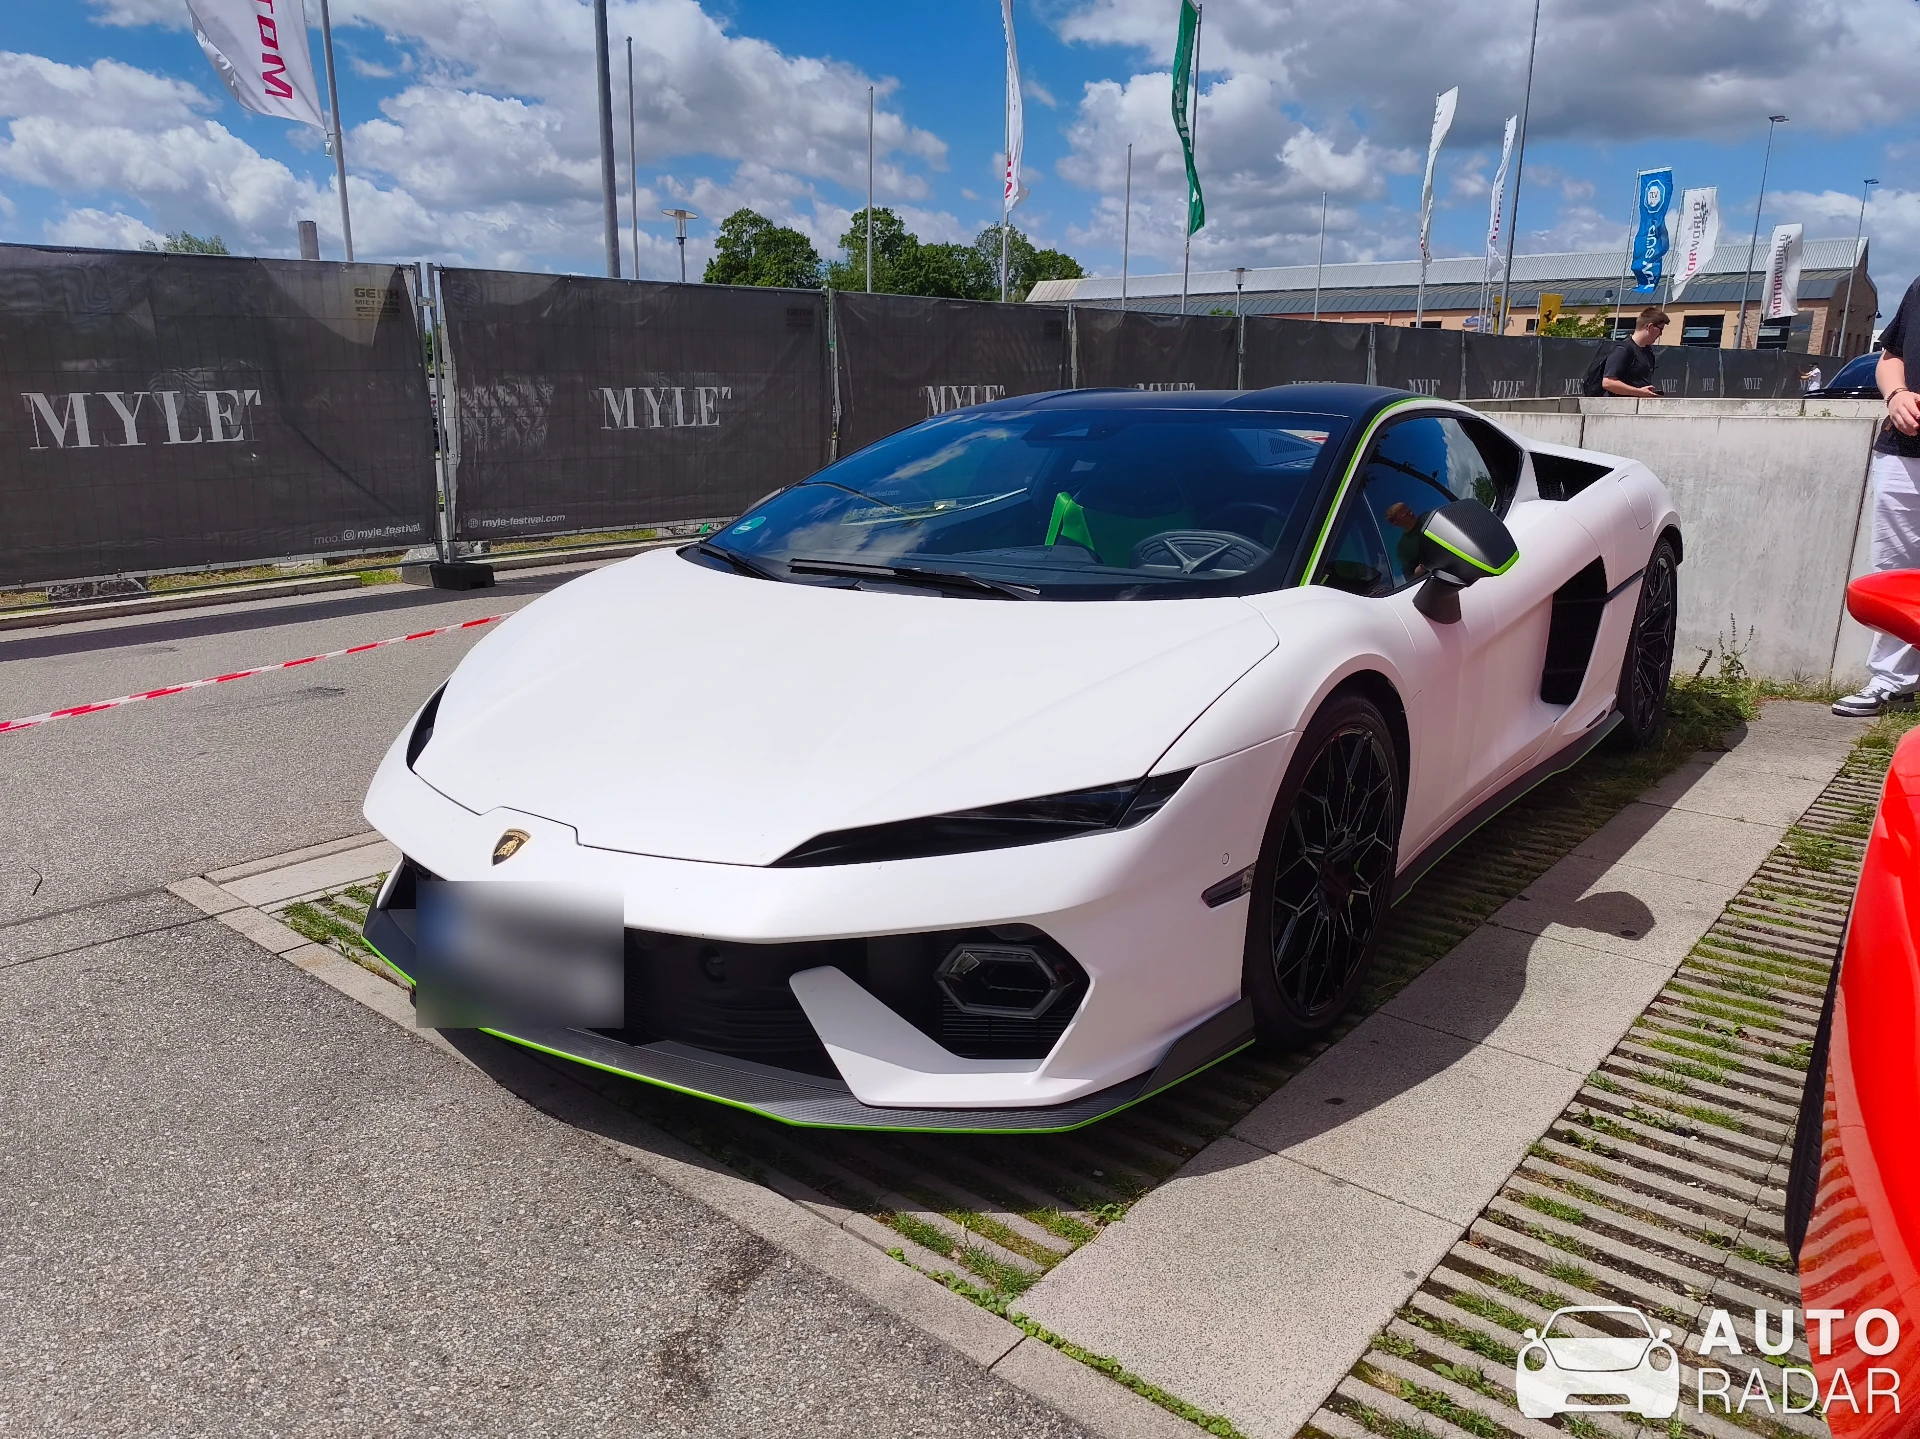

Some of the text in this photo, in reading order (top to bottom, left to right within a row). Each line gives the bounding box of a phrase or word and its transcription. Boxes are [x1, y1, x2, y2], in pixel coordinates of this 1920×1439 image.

[354, 287, 400, 299] GEITH
[482, 514, 566, 528] myle-festival.com
[357, 523, 420, 540] myle_festival
